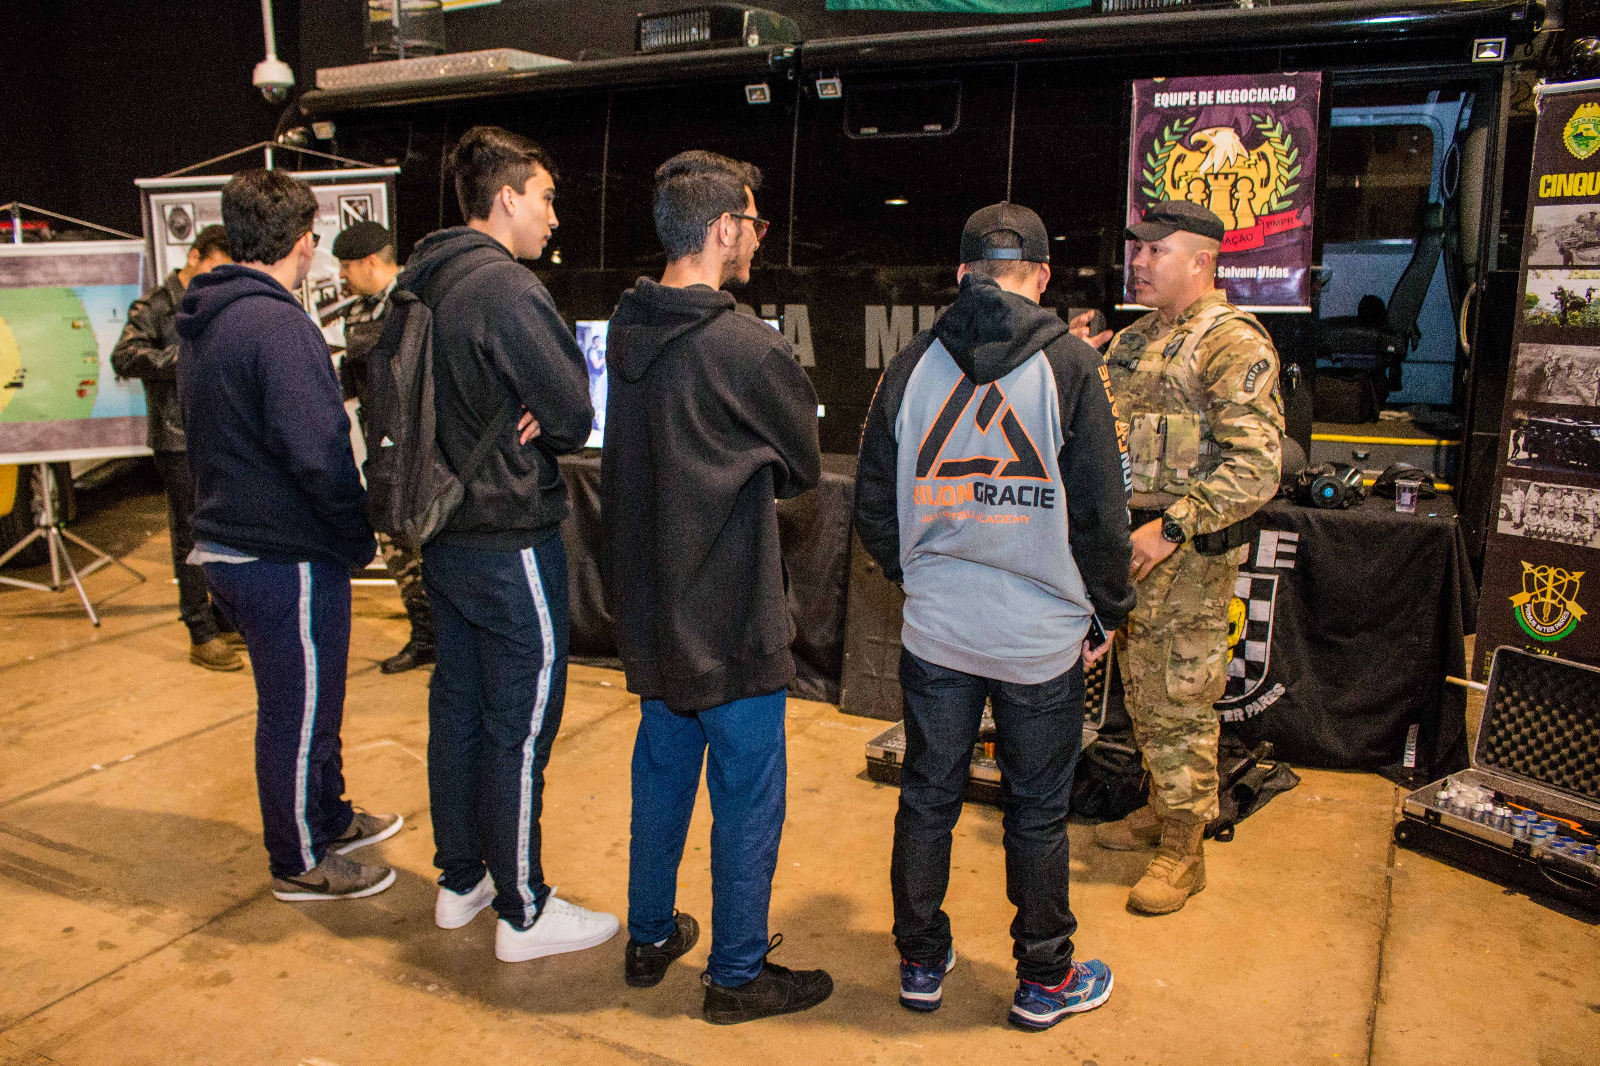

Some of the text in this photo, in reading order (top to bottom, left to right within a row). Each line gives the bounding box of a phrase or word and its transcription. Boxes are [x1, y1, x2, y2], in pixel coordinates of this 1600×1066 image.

[1154, 84, 1296, 108] EQUIPE DE NEGOCIAÇÃO
[1266, 216, 1294, 229] PMPR
[1218, 266, 1289, 279] Salvam Vidas
[1536, 625, 1557, 633] INTER
[1554, 611, 1570, 630] PARES
[1245, 682, 1286, 719] PARES
